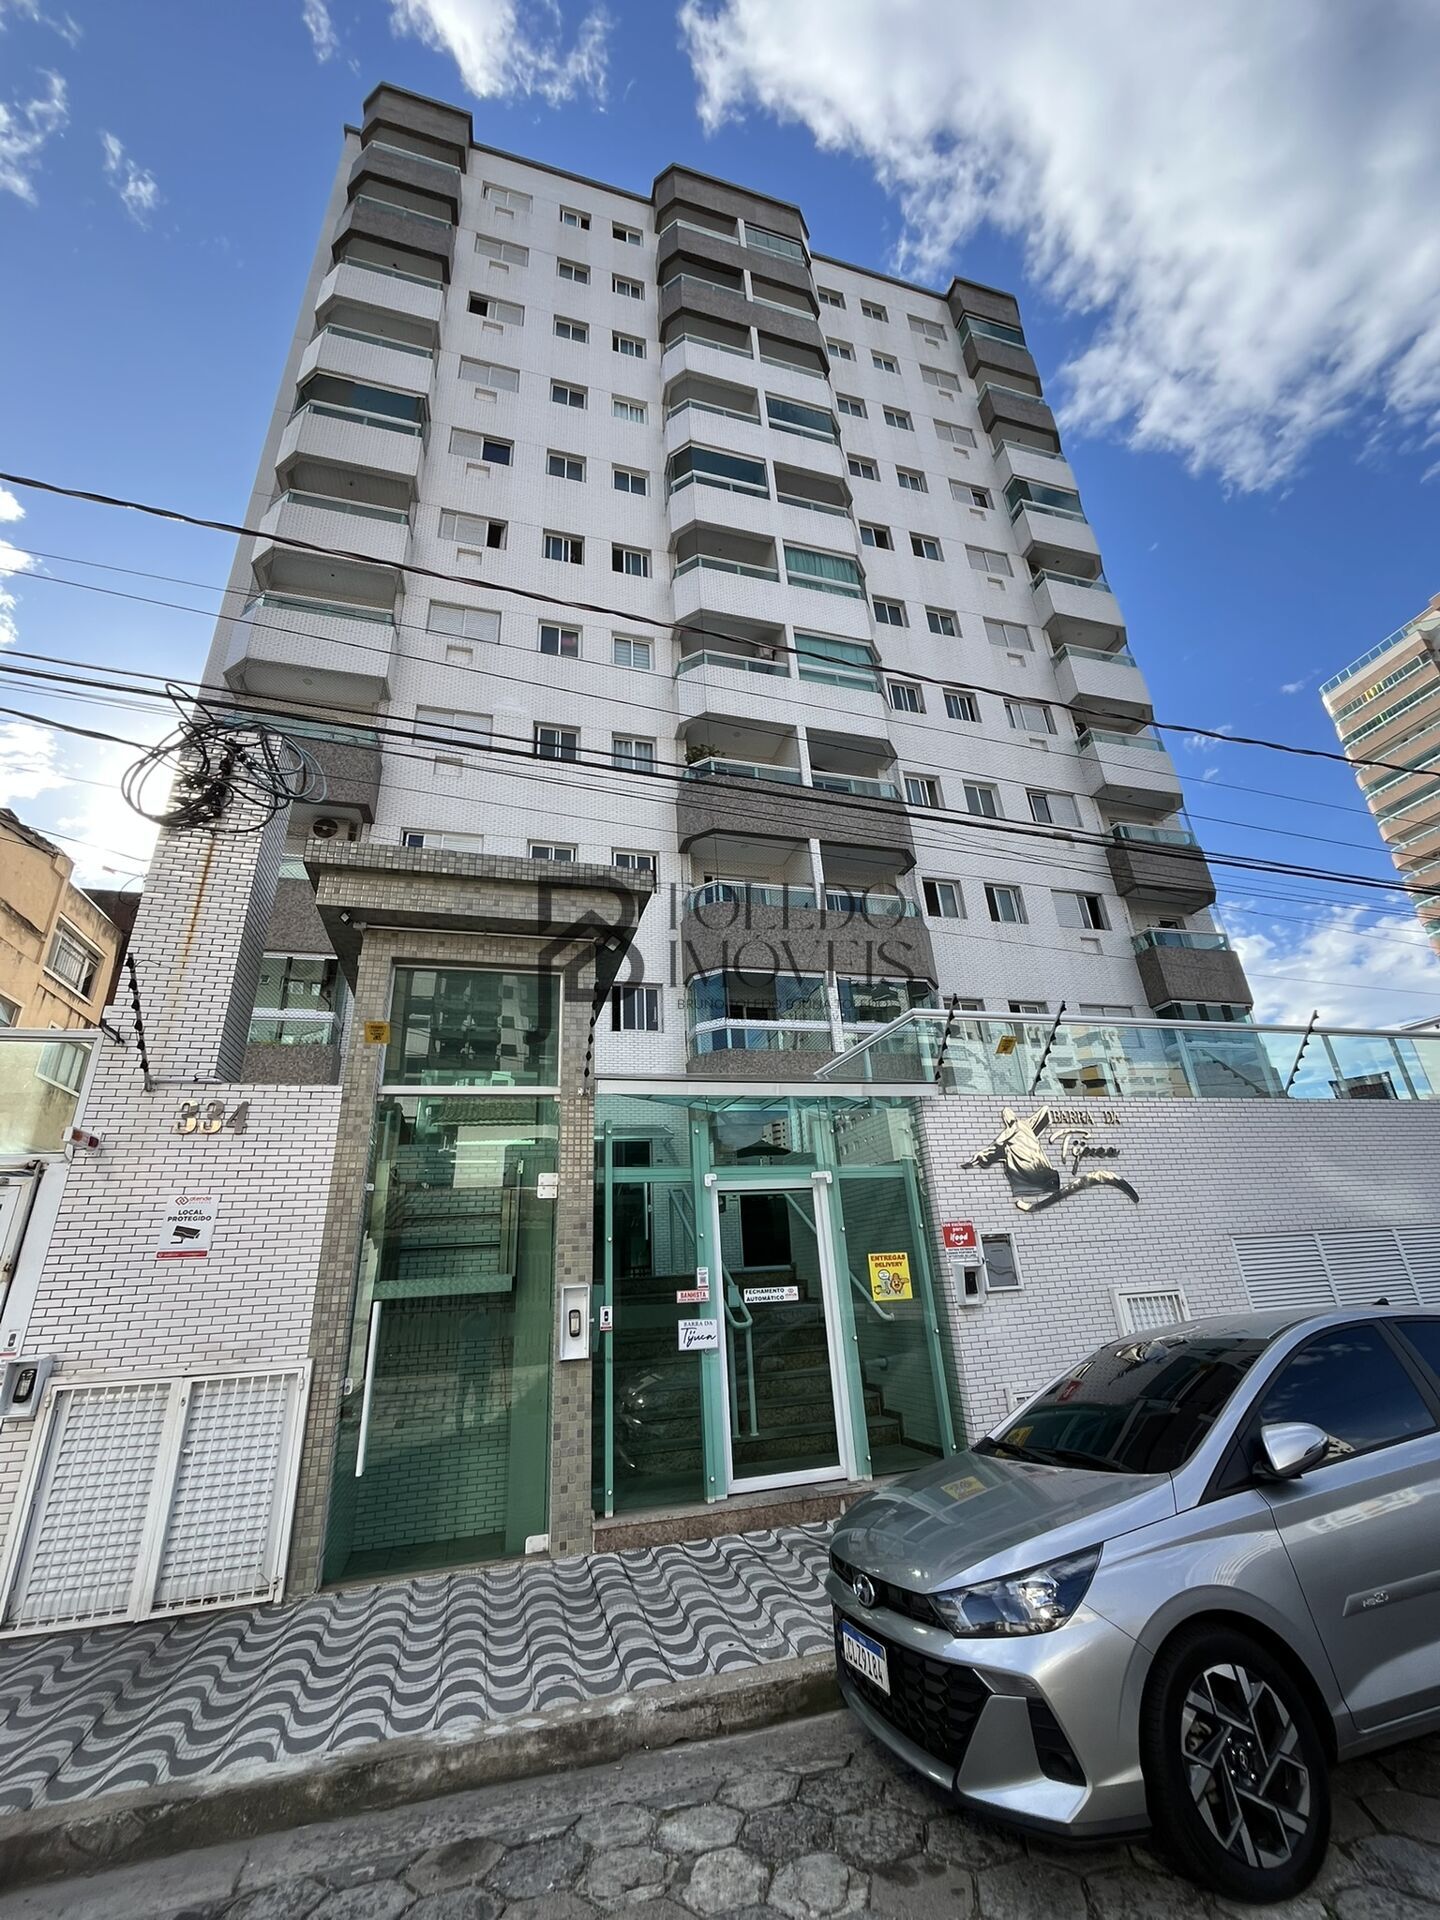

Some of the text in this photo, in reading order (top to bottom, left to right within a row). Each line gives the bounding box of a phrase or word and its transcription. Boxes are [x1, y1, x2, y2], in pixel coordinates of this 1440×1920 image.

[172, 1100, 250, 1135] 334
[1049, 1110, 1122, 1126] BARRA DA
[680, 1291, 707, 1299] BANHISTA
[745, 1287, 785, 1295] FECHAMENTO
